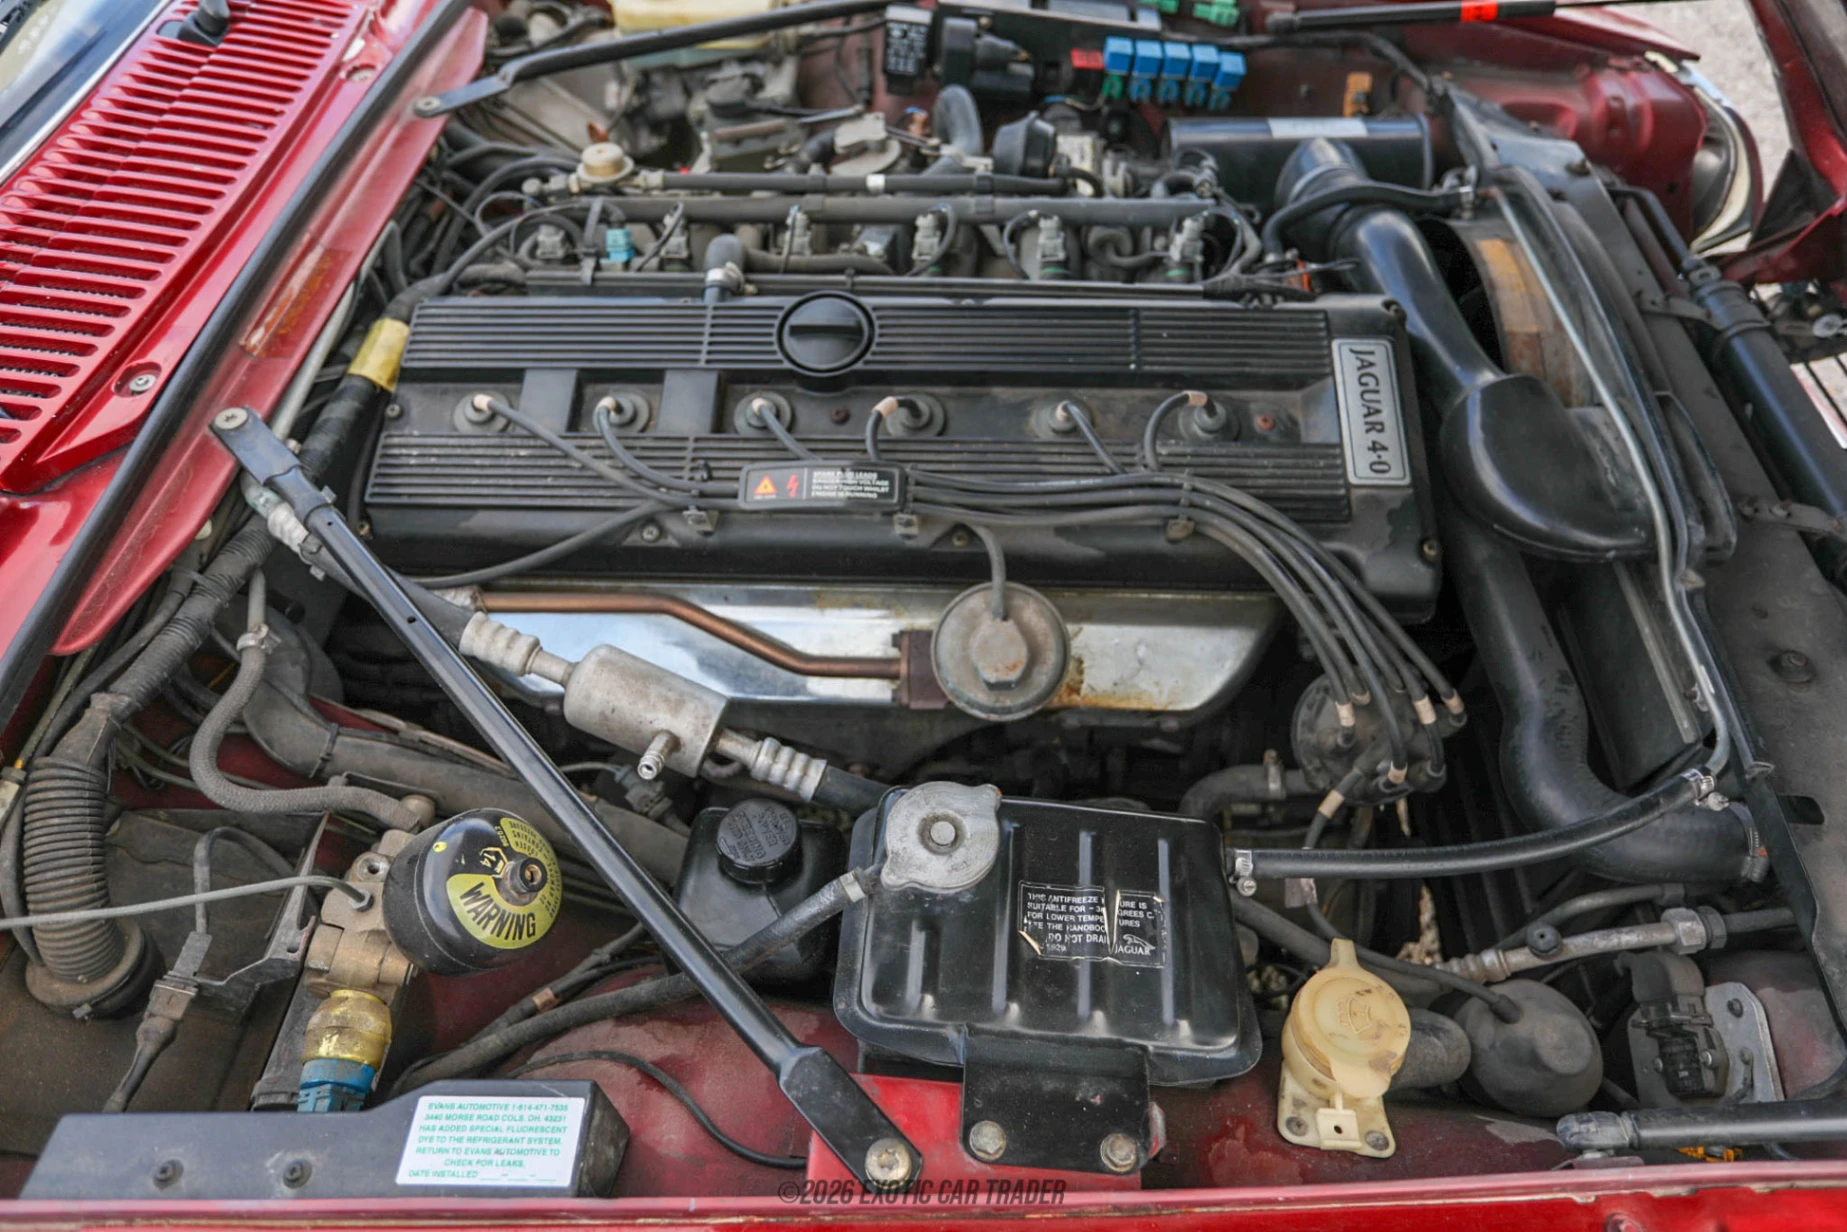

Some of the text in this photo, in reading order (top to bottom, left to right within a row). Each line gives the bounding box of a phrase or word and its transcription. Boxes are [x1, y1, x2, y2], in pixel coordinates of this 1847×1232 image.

[1349, 348, 1386, 435] JAGUAR
[480, 852, 496, 868] 14
[1048, 894, 1098, 904] ANTIFREEZE
[460, 882, 536, 940] WARNING
[1028, 902, 1066, 912] SUITABLE
[1069, 904, 1086, 912] FOR
[1028, 910, 1044, 919] FOR
[1046, 912, 1076, 922] LOWER
[1046, 922, 1064, 931] THE
[1066, 924, 1107, 932] HANDBOO
[1048, 932, 1107, 944] DO NOT DRAI
[1114, 944, 1151, 956] JAGUAR
[428, 1102, 456, 1110] EVANS
[457, 1102, 509, 1110] AUTOMOTIVE
[466, 1136, 525, 1144] REFRIGERANT
[494, 1148, 548, 1156] AUTOMOTIVE
[432, 1170, 478, 1178] INSTALLED
